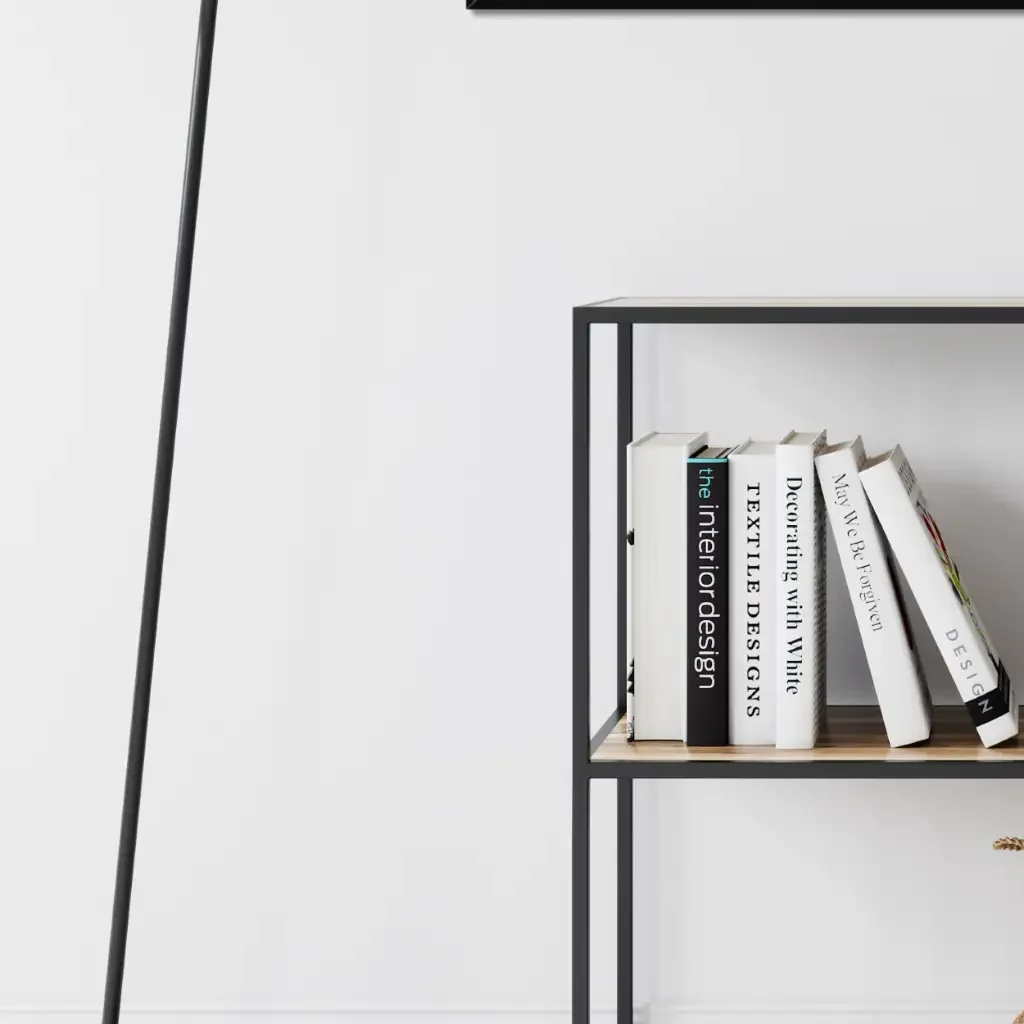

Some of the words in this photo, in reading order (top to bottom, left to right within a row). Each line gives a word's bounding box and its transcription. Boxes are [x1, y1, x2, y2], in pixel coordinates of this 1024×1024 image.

[698, 467, 715, 499] the
[832, 473, 850, 507] May
[698, 504, 720, 598] interior
[746, 482, 760, 593] TEXTILE
[781, 477, 803, 582] Decorating
[843, 509, 859, 537] We
[849, 539, 867, 561] Be
[786, 588, 803, 630] with
[856, 562, 884, 632] Forgiven
[694, 601, 721, 688] design
[746, 602, 761, 717] DESIGNS
[786, 636, 803, 695] White
[946, 628, 993, 714] DESIGN
